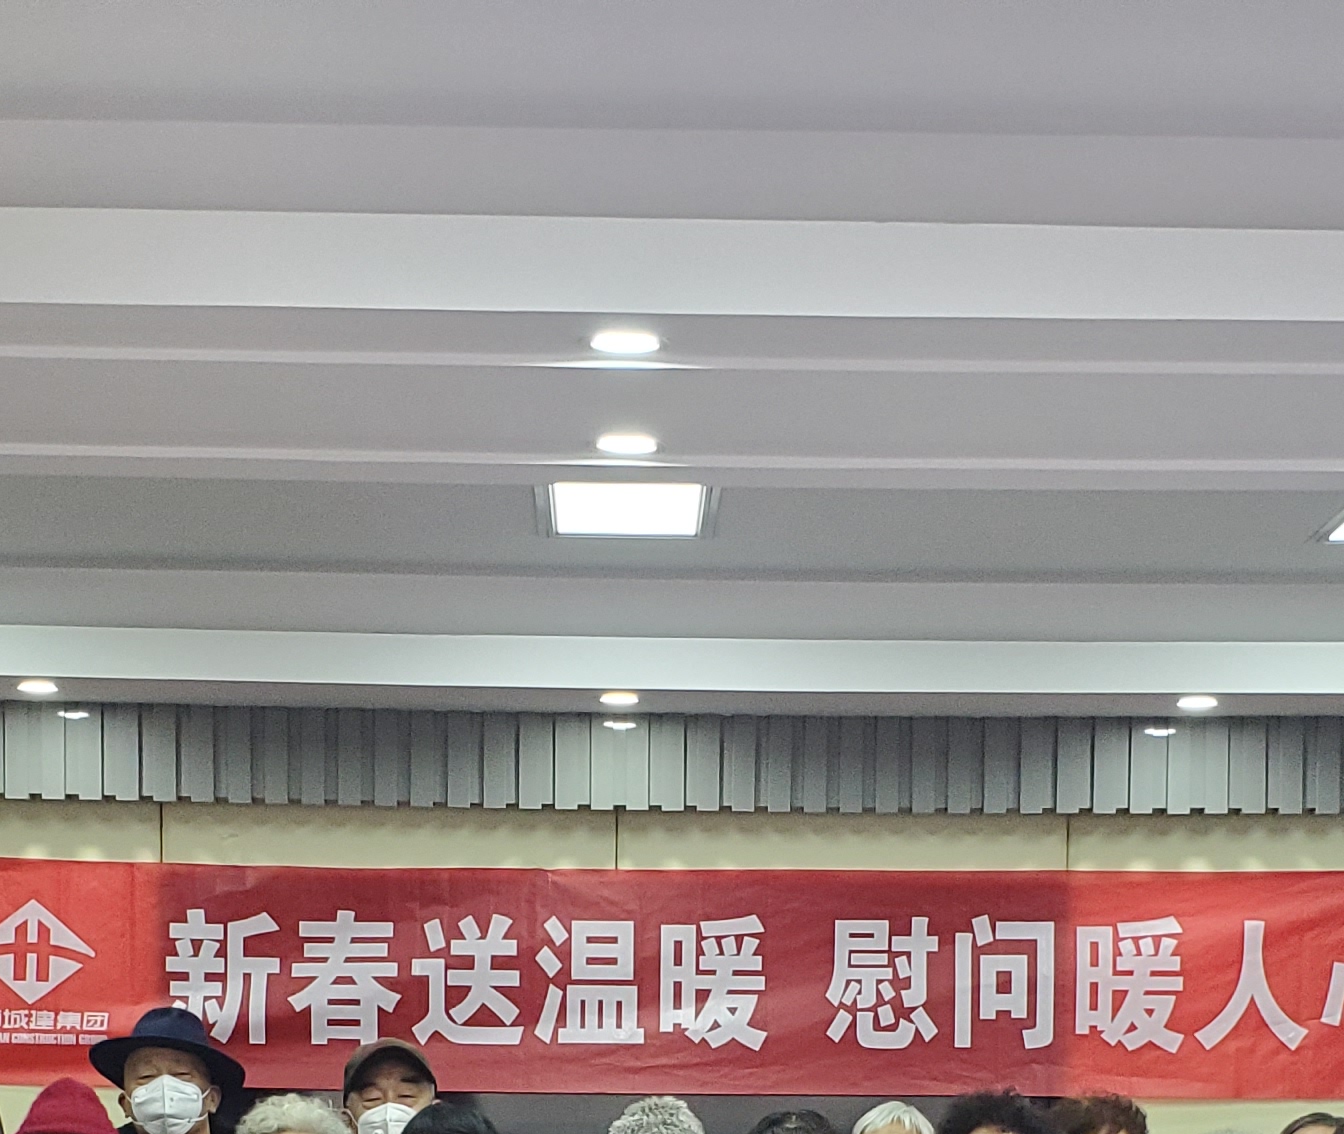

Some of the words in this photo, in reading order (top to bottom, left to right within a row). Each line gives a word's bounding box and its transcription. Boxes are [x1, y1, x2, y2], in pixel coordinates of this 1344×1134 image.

[164, 908, 768, 1052] 新春送温暖
